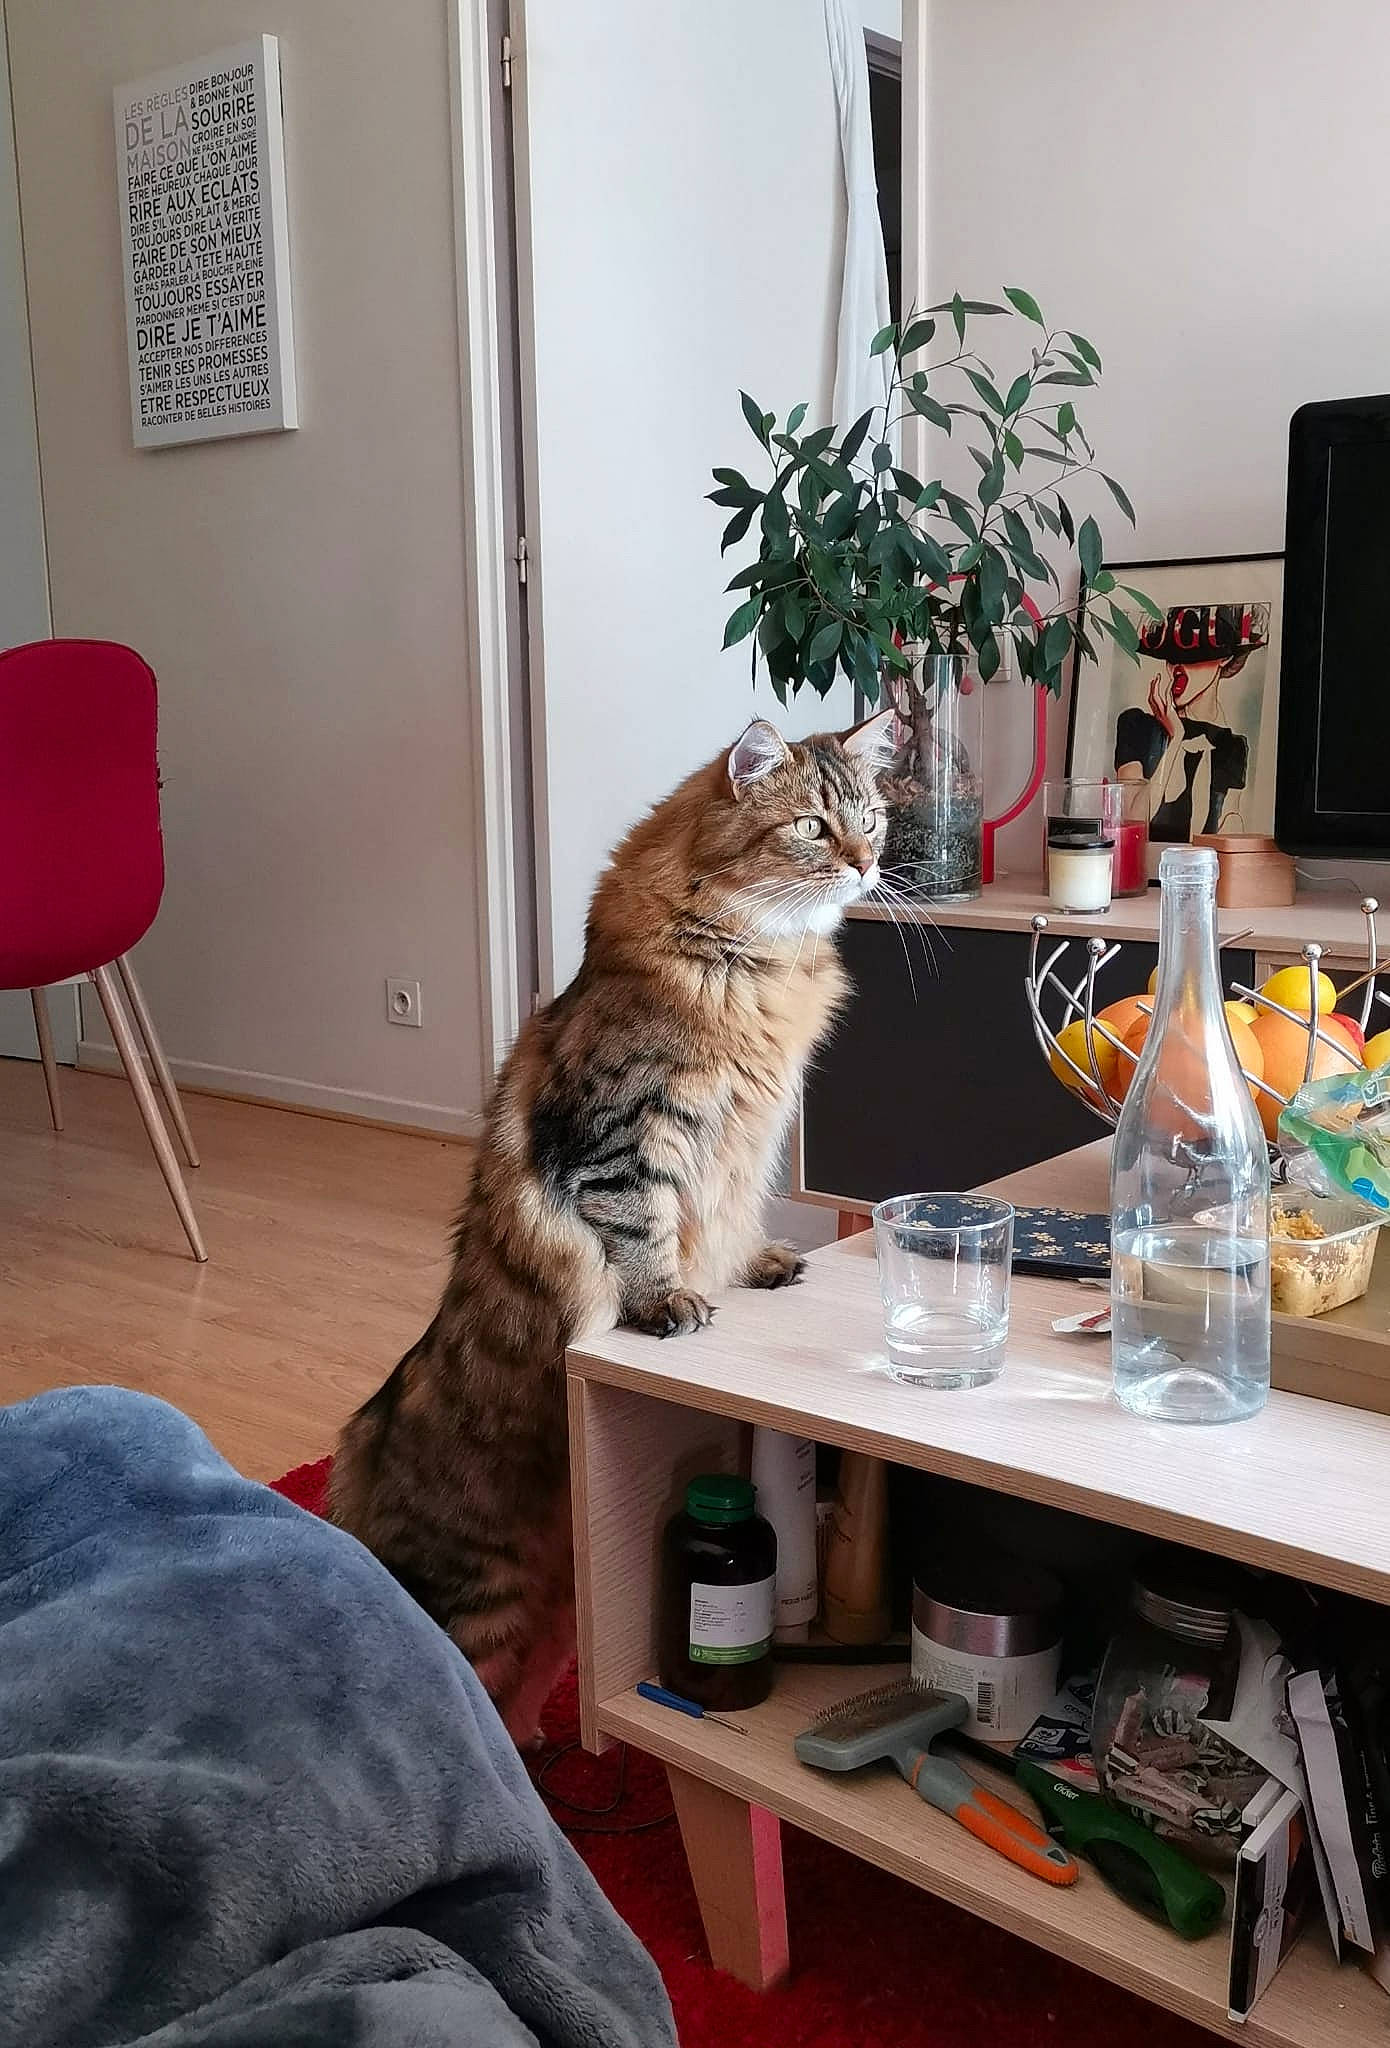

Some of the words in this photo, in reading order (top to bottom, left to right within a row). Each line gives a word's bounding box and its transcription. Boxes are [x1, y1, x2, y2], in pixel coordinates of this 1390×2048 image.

[190, 78, 209, 94] DIRE
[212, 63, 253, 87] BONJOUR
[199, 85, 230, 106] BONNE
[233, 78, 254, 95] NUIT
[125, 102, 143, 120] LES
[126, 116, 153, 150] DE
[161, 103, 189, 139] LA
[191, 93, 255, 130] SOURIRE
[192, 125, 224, 144] CROIRE
[227, 121, 238, 134] EN
[127, 136, 191, 175] MAISON
[128, 170, 157, 190] FAIRE
[160, 165, 173, 181] CE
[176, 157, 198, 177] QUE
[202, 149, 227, 169] L'ON
[230, 140, 257, 160] AIME
[152, 175, 191, 197] HEUREUX
[194, 164, 230, 184] CHAQUE
[233, 156, 257, 173] JOUR
[130, 198, 161, 223] RIRE
[166, 187, 196, 214] AUX
[202, 170, 259, 203] ECLATS
[131, 221, 150, 237] DIRE
[153, 218, 167, 231] S'IL
[169, 210, 192, 226] VOUS
[196, 202, 221, 219] PLAIT
[223, 200, 228, 212] &
[232, 192, 260, 209] MERCI
[132, 227, 181, 250] TOUJOURS
[184, 220, 206, 237] DIRE
[209, 216, 222, 231] LA
[225, 206, 260, 227] VERITE
[133, 246, 166, 268] FAIRE
[170, 240, 187, 259] DE
[190, 233, 217, 254] SON
[221, 221, 261, 246] MIEUX
[134, 262, 176, 284] GARDER
[179, 258, 192, 273] LA
[196, 251, 222, 269] TETE
[225, 241, 263, 262] HAUTE
[146, 282, 158, 293] PAS
[161, 274, 189, 290] PARLER
[191, 272, 200, 282] LA
[203, 264, 234, 280] BOUCHE
[236, 257, 263, 271] PLEINE
[135, 284, 201, 313] TOUJOURS
[206, 270, 264, 298] ESSAYER
[136, 307, 184, 326] PARDONNER
[187, 301, 210, 316] MEME
[212, 299, 219, 310] SI
[222, 294, 244, 308] C'EST
[247, 290, 265, 303] DUR
[137, 322, 176, 350] DIRE
[181, 317, 201, 342] JE
[207, 304, 266, 337] T'AIME
[138, 346, 182, 365] ACCEPTER
[184, 342, 203, 356] NOS
[205, 330, 267, 352] DIFFERENCES
[139, 363, 171, 382] TENIR
[174, 358, 195, 375] SES
[198, 345, 268, 371] PROMESSES
[140, 380, 173, 395] S'AIMER
[175, 376, 191, 389] LES
[193, 373, 211, 386] UNS
[214, 369, 230, 383] LES
[233, 363, 269, 379] AUTRES
[141, 394, 172, 414] ETRE
[175, 378, 270, 409] RESPECTUEUX
[142, 412, 183, 427] RACONTER
[185, 409, 195, 421] DE
[198, 404, 226, 419] BELLES
[229, 397, 271, 414] HISTOIRES
